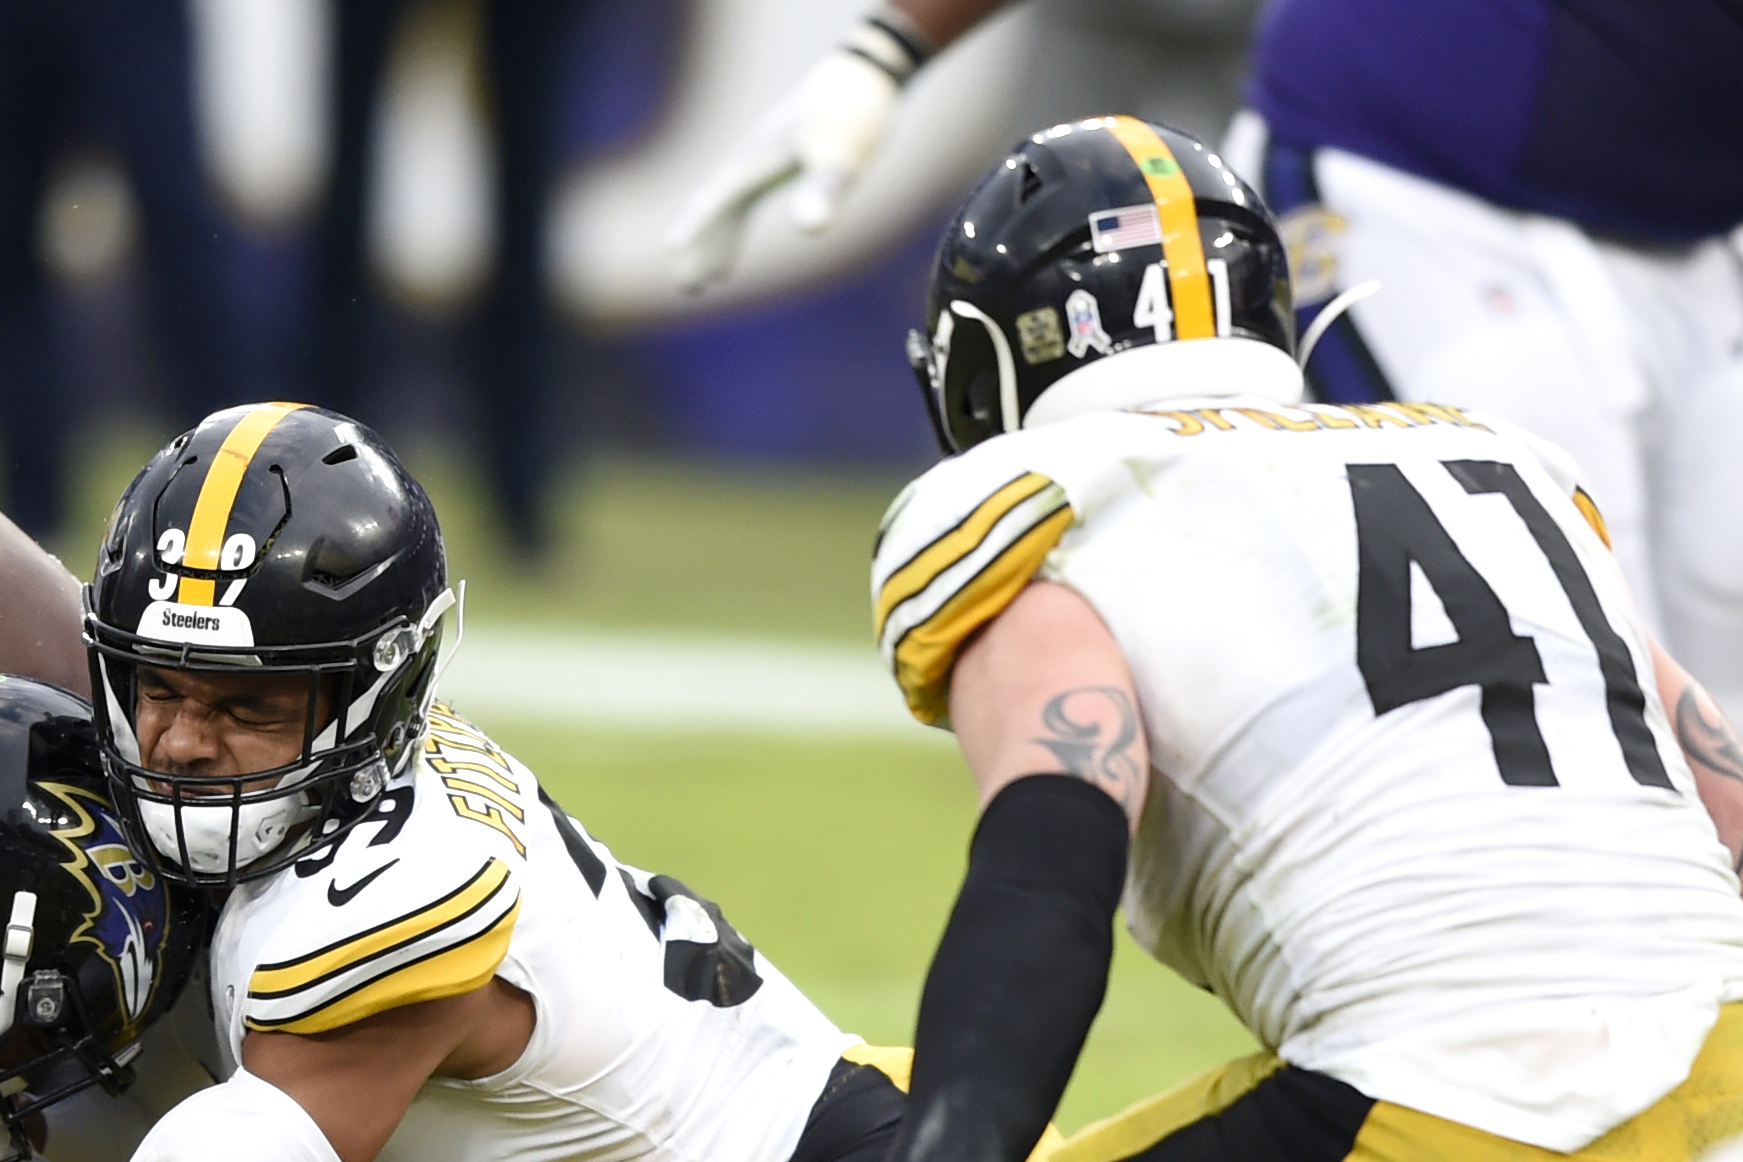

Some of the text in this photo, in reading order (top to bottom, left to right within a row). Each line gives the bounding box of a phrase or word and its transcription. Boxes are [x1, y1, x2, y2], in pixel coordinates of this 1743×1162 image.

[1133, 258, 1233, 342] 41
[147, 528, 257, 606] 39
[161, 608, 221, 631] Steelers
[1345, 459, 1682, 796] 41
